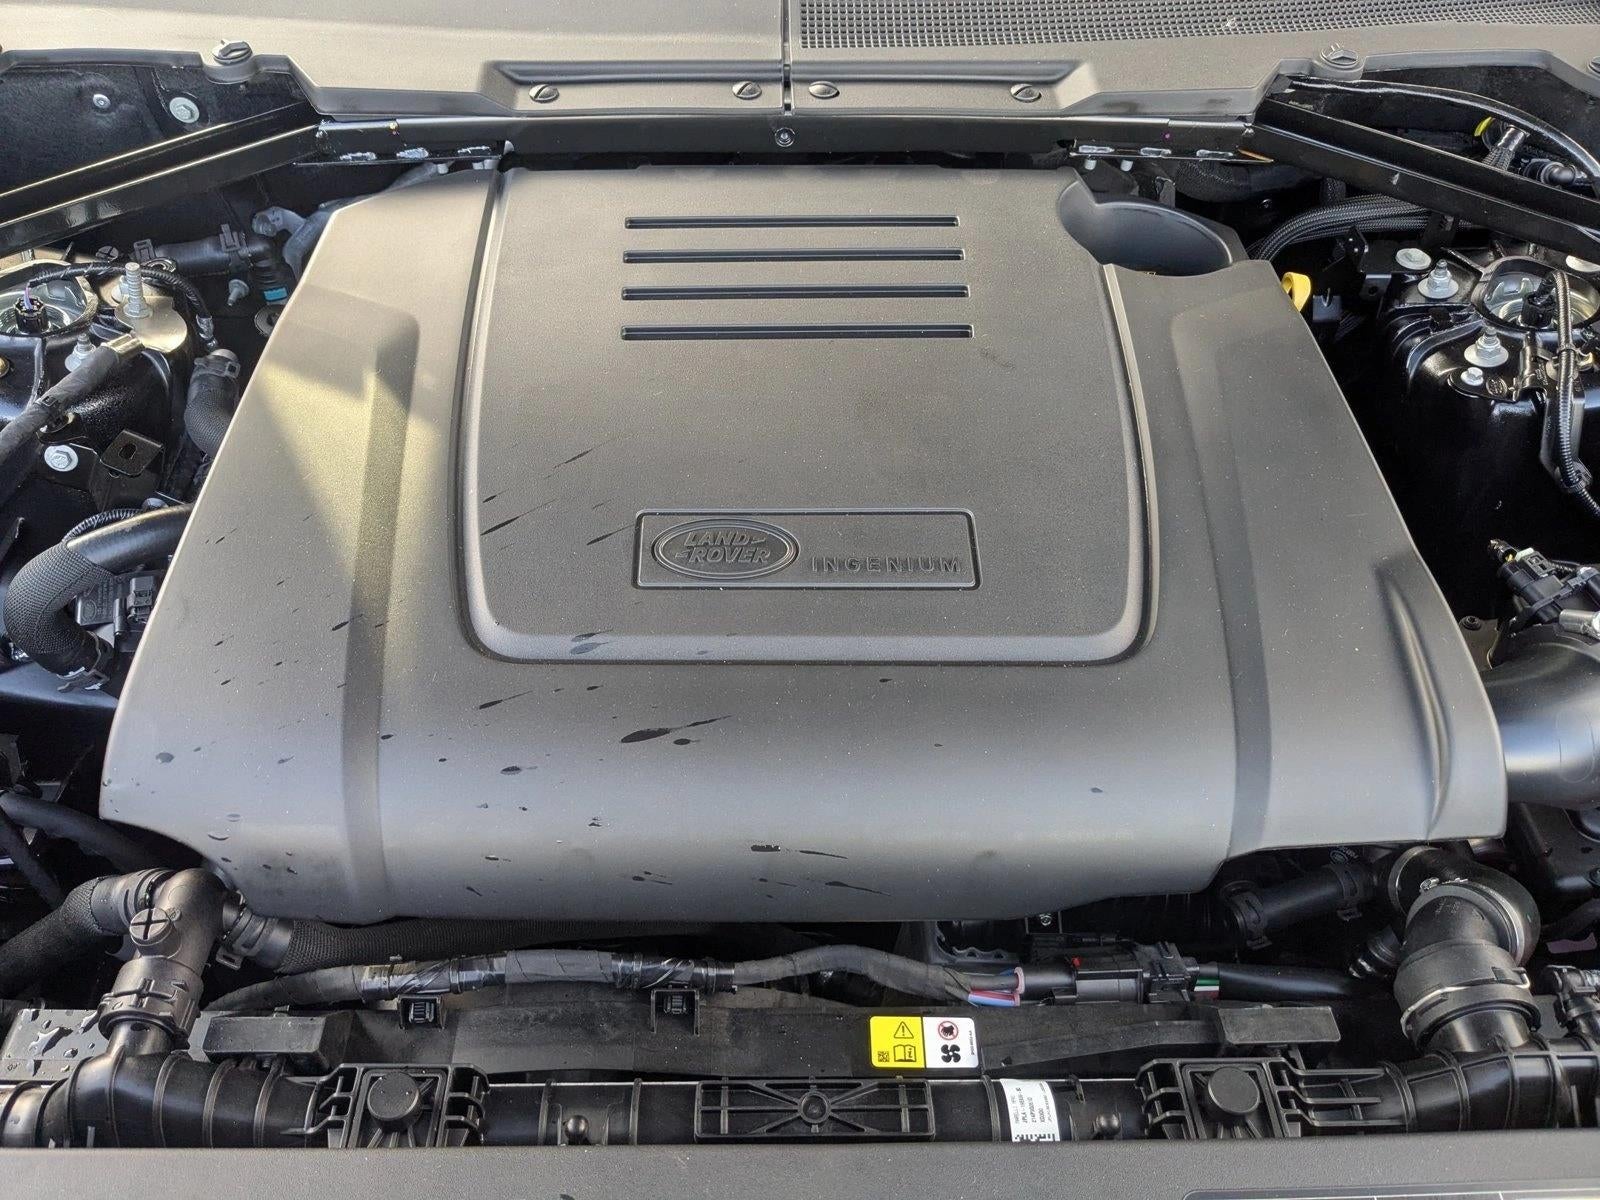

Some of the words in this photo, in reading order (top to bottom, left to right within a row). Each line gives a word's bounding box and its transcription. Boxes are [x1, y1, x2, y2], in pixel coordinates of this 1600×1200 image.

[684, 531, 749, 547] LAND
[689, 545, 771, 564] ROVER
[811, 556, 961, 573] INGENIUM
